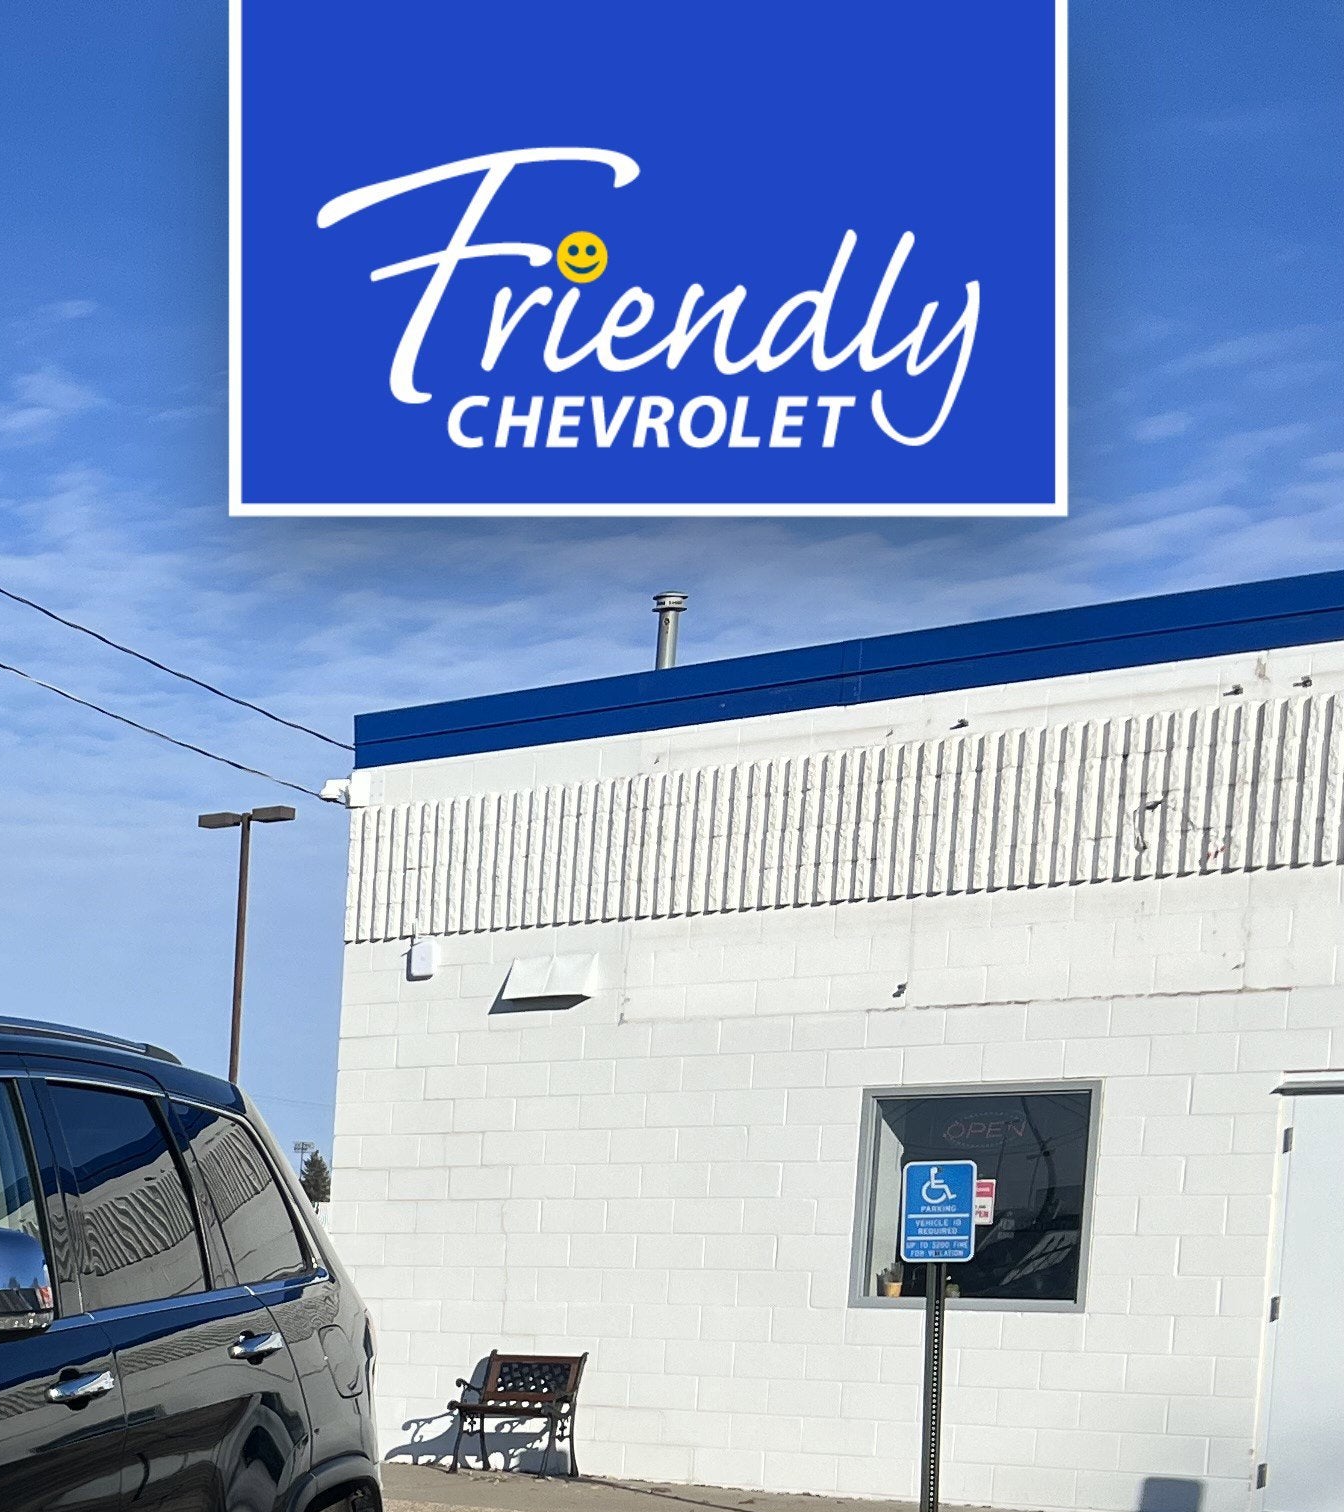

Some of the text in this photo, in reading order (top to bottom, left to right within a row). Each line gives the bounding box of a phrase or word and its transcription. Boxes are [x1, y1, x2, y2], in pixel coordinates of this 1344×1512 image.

[946, 1119, 1027, 1141] OPEN
[920, 1204, 957, 1213] PARKING
[915, 1219, 950, 1227] VEHICLE
[917, 1228, 958, 1236] REQUIRED
